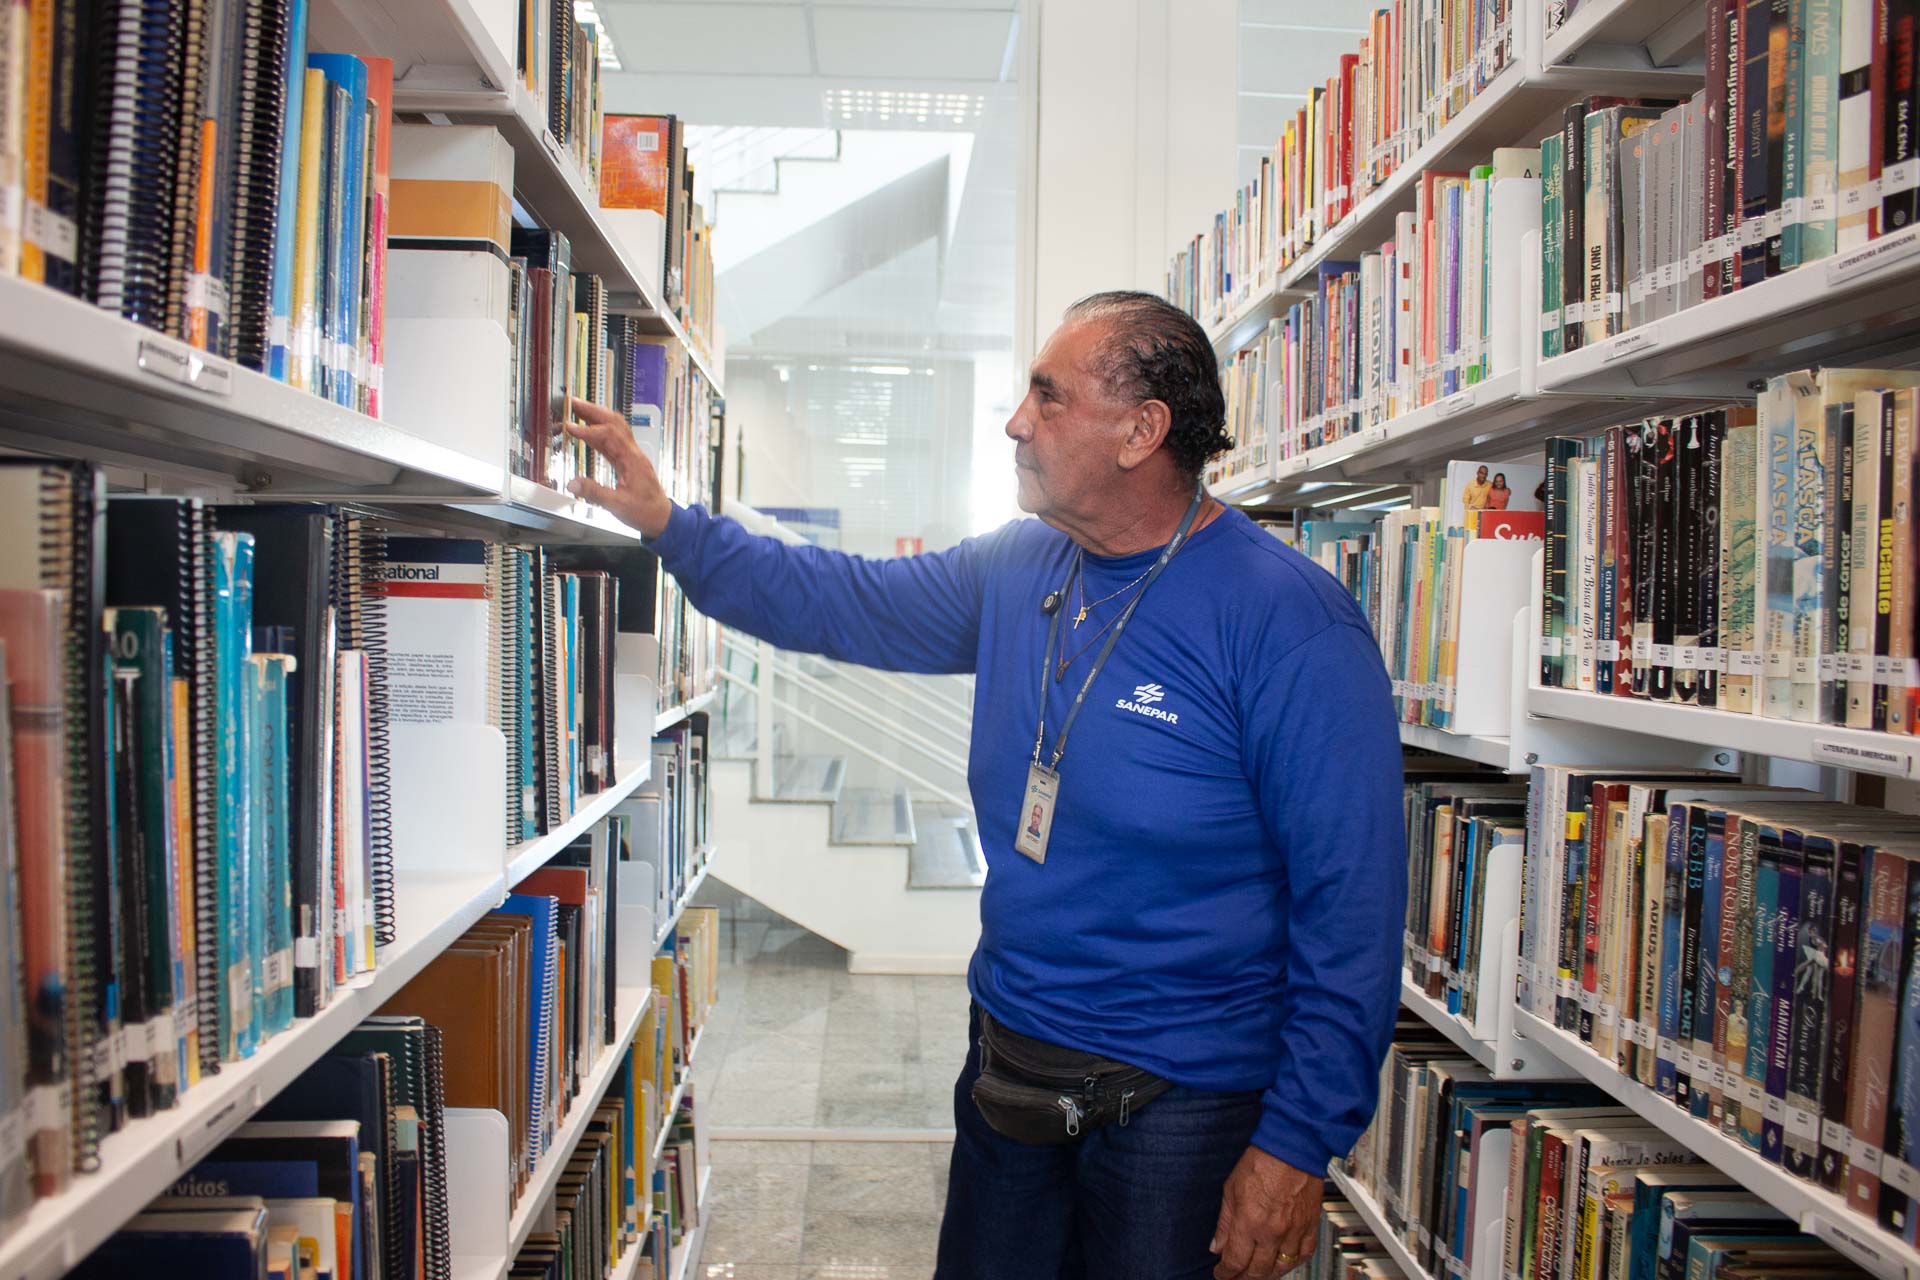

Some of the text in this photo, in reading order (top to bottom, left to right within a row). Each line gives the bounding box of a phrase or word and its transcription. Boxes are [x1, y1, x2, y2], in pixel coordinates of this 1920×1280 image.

[1729, 19, 1739, 43] rua
[1729, 44, 1739, 62] da
[1811, 12, 1830, 56] STAN
[1728, 63, 1738, 87] fim
[1728, 87, 1738, 106] do
[1727, 106, 1738, 153] menina
[1785, 132, 1796, 190] HARPER
[1590, 245, 1602, 271] KING
[1839, 233, 1917, 270] LITERATURA AMERICANA
[1547, 457, 1555, 491] MADELINE
[1708, 435, 1718, 497] hospedeira
[1896, 416, 1910, 490] DEWEY
[1586, 470, 1596, 497] Judith
[1771, 433, 1790, 546] ALASCA
[1797, 428, 1817, 546] ALASCA
[1583, 554, 1595, 625] Em Busca do
[1877, 518, 1894, 615] nocaute
[1603, 570, 1613, 641] CLAIRE MESS
[1837, 591, 1849, 615] de
[1115, 698, 1179, 725] SANEPAR
[1822, 743, 1898, 764] LITERATURA AMERICANA
[1669, 816, 1681, 862] Roberts
[1688, 825, 1706, 889] ROBB
[1743, 831, 1755, 860] NORA
[1529, 866, 1537, 906] ALICE
[1721, 831, 1740, 953] NORA ROBERTS
[1740, 863, 1753, 909] ROBERTS
[1873, 865, 1890, 922] Roberts
[1585, 889, 1595, 945] A FARSA
[1648, 898, 1660, 958] ADEUS,
[1754, 902, 1778, 948] Nora Roberts
[1776, 907, 1799, 953] Nora Roberts
[1773, 997, 1791, 1070] MANHATTAN
